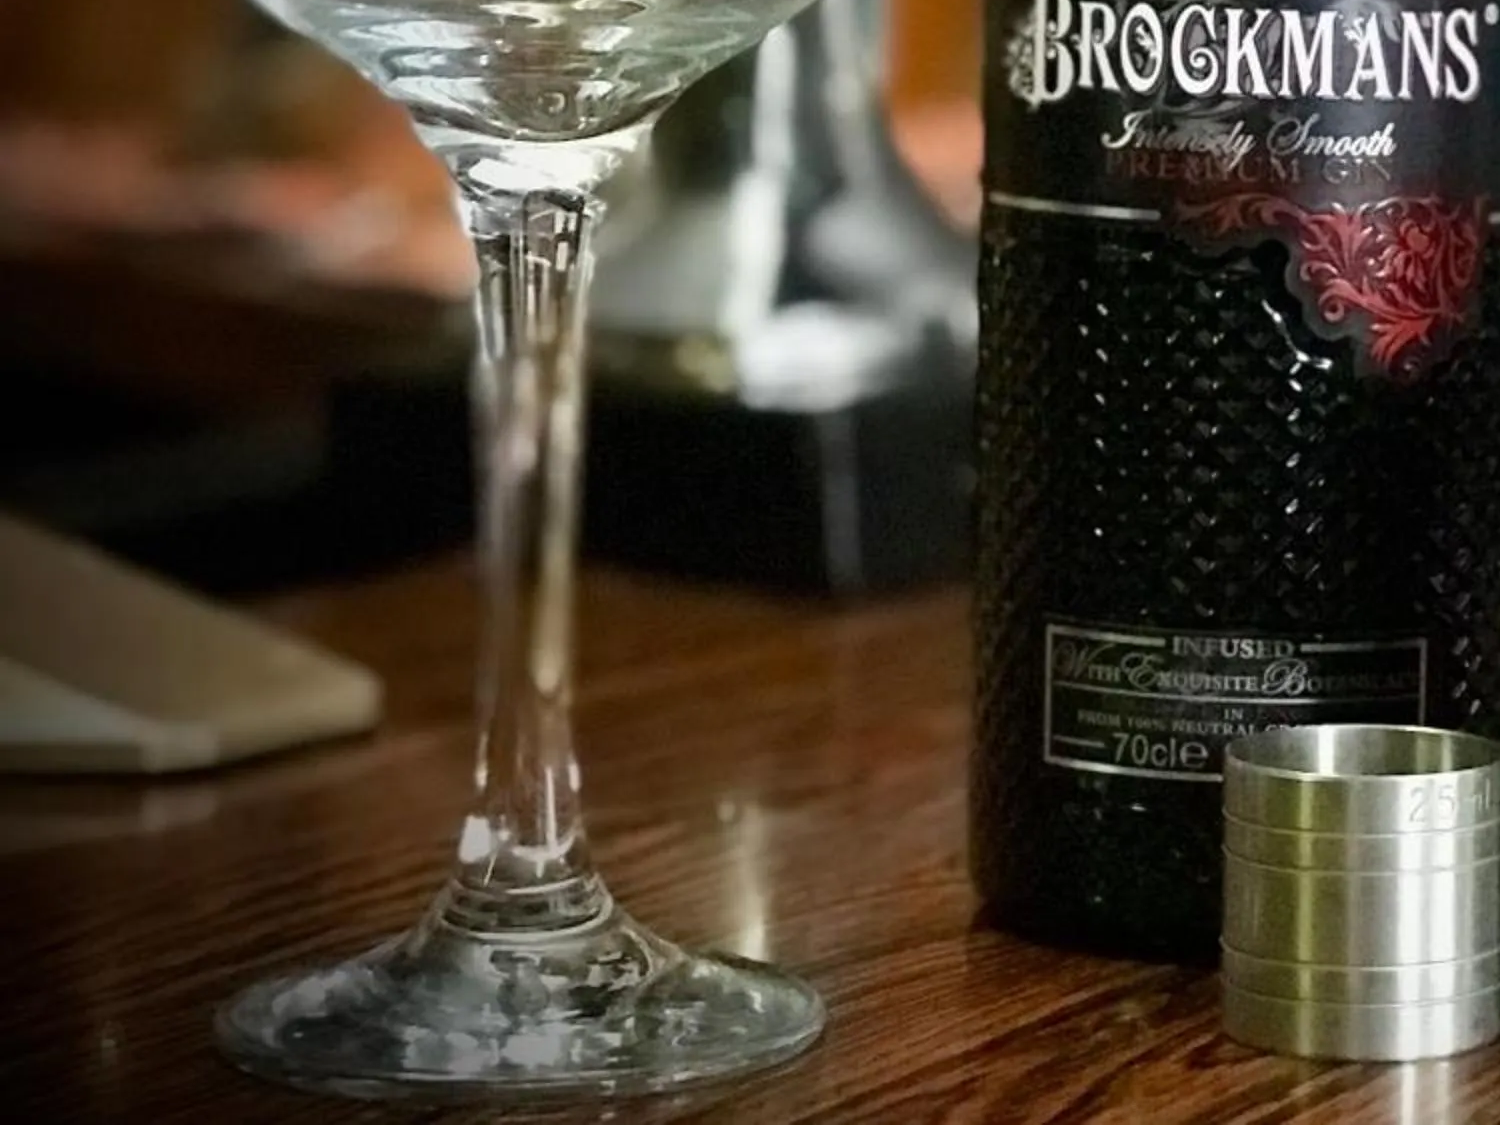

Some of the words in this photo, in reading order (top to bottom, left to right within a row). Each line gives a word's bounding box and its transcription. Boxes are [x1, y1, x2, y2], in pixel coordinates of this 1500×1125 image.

[1101, 108, 1256, 172] Intensely
[1266, 112, 1398, 157] Smooth
[1172, 636, 1296, 660] INFUSED
[1223, 708, 1244, 721] IN
[1171, 720, 1255, 737] NEUTRAL
